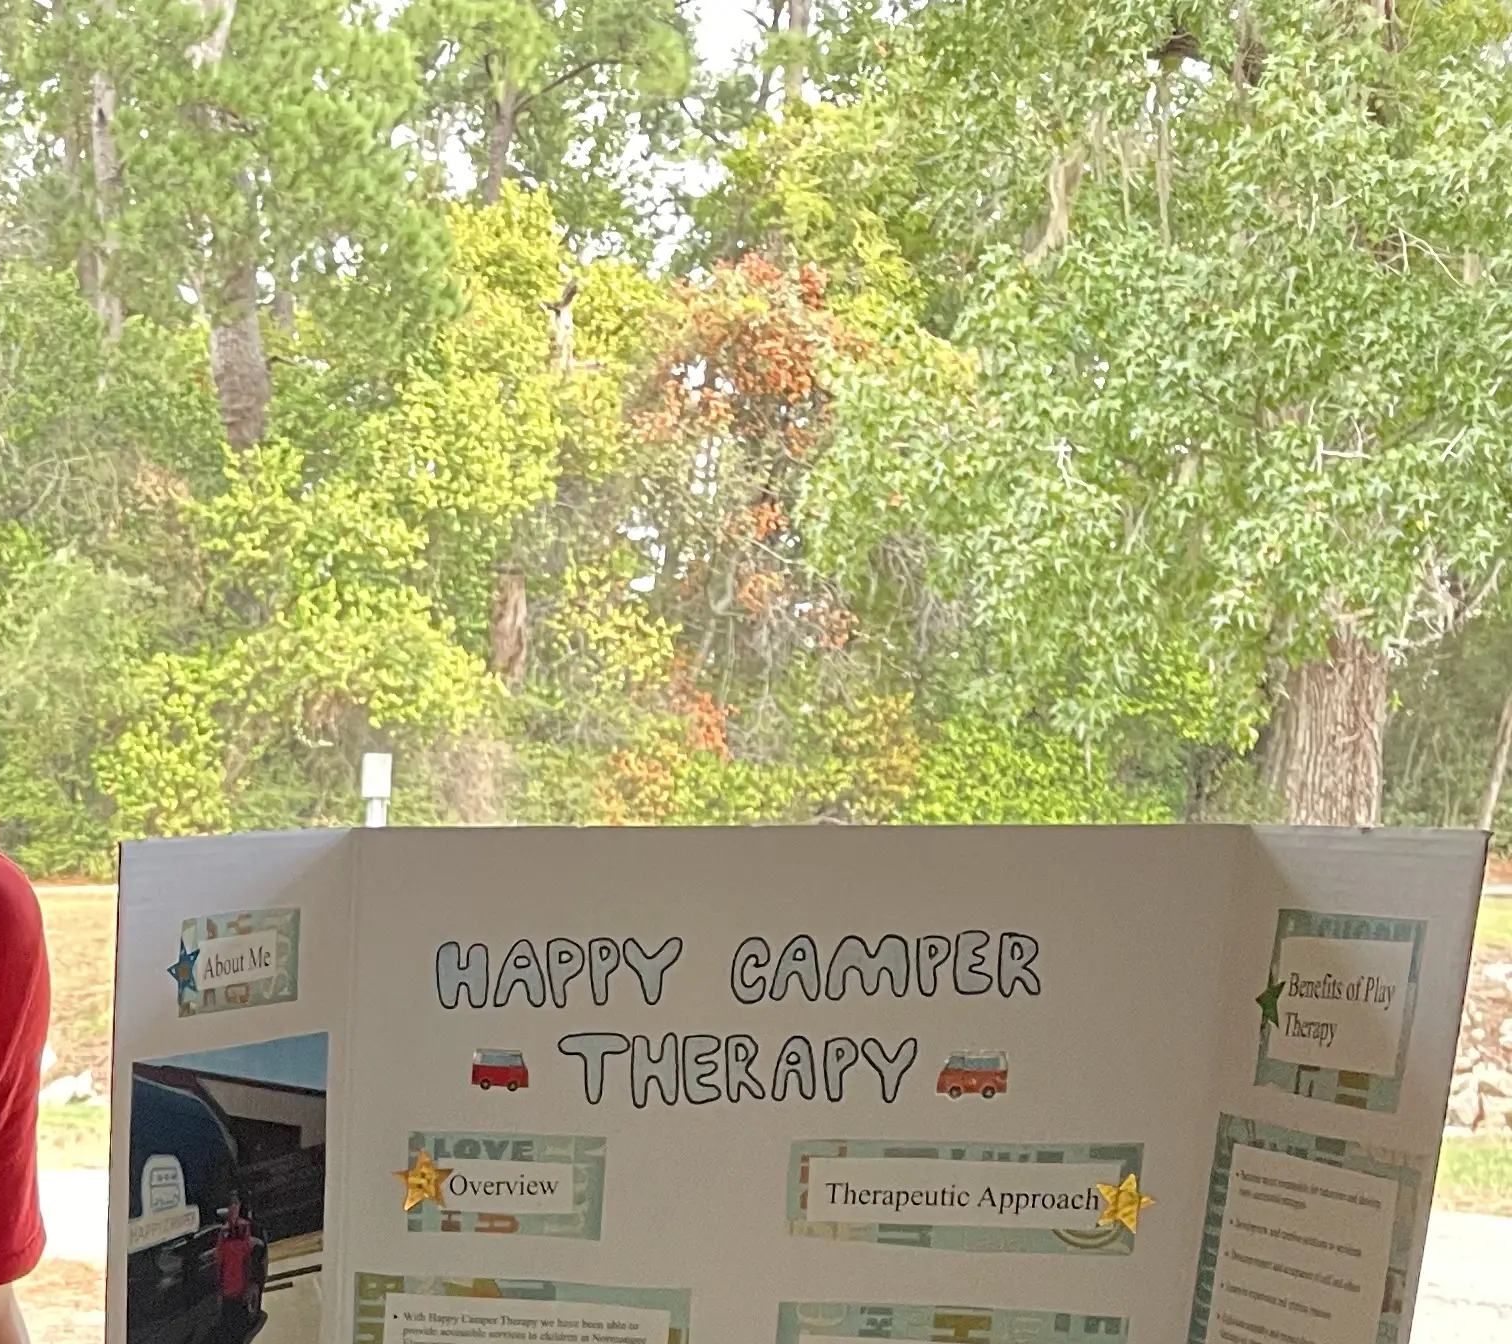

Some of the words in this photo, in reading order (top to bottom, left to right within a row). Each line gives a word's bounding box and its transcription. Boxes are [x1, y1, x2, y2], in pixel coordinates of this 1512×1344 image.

[203, 953, 246, 981] About
[248, 946, 272, 971] Me
[435, 936, 683, 1009] HAPPY
[731, 930, 1041, 1003] CAMPER
[1288, 972, 1343, 1000] Benefits
[1346, 976, 1366, 1001] of
[1364, 976, 1396, 1011] Play
[1285, 1012, 1338, 1048] Therapy
[558, 1031, 917, 1108] THERAPY
[434, 1137, 534, 1161] LOVE
[449, 1173, 560, 1196] Overview
[826, 1182, 970, 1212] Therapeutic
[977, 1186, 1100, 1215] Approach
